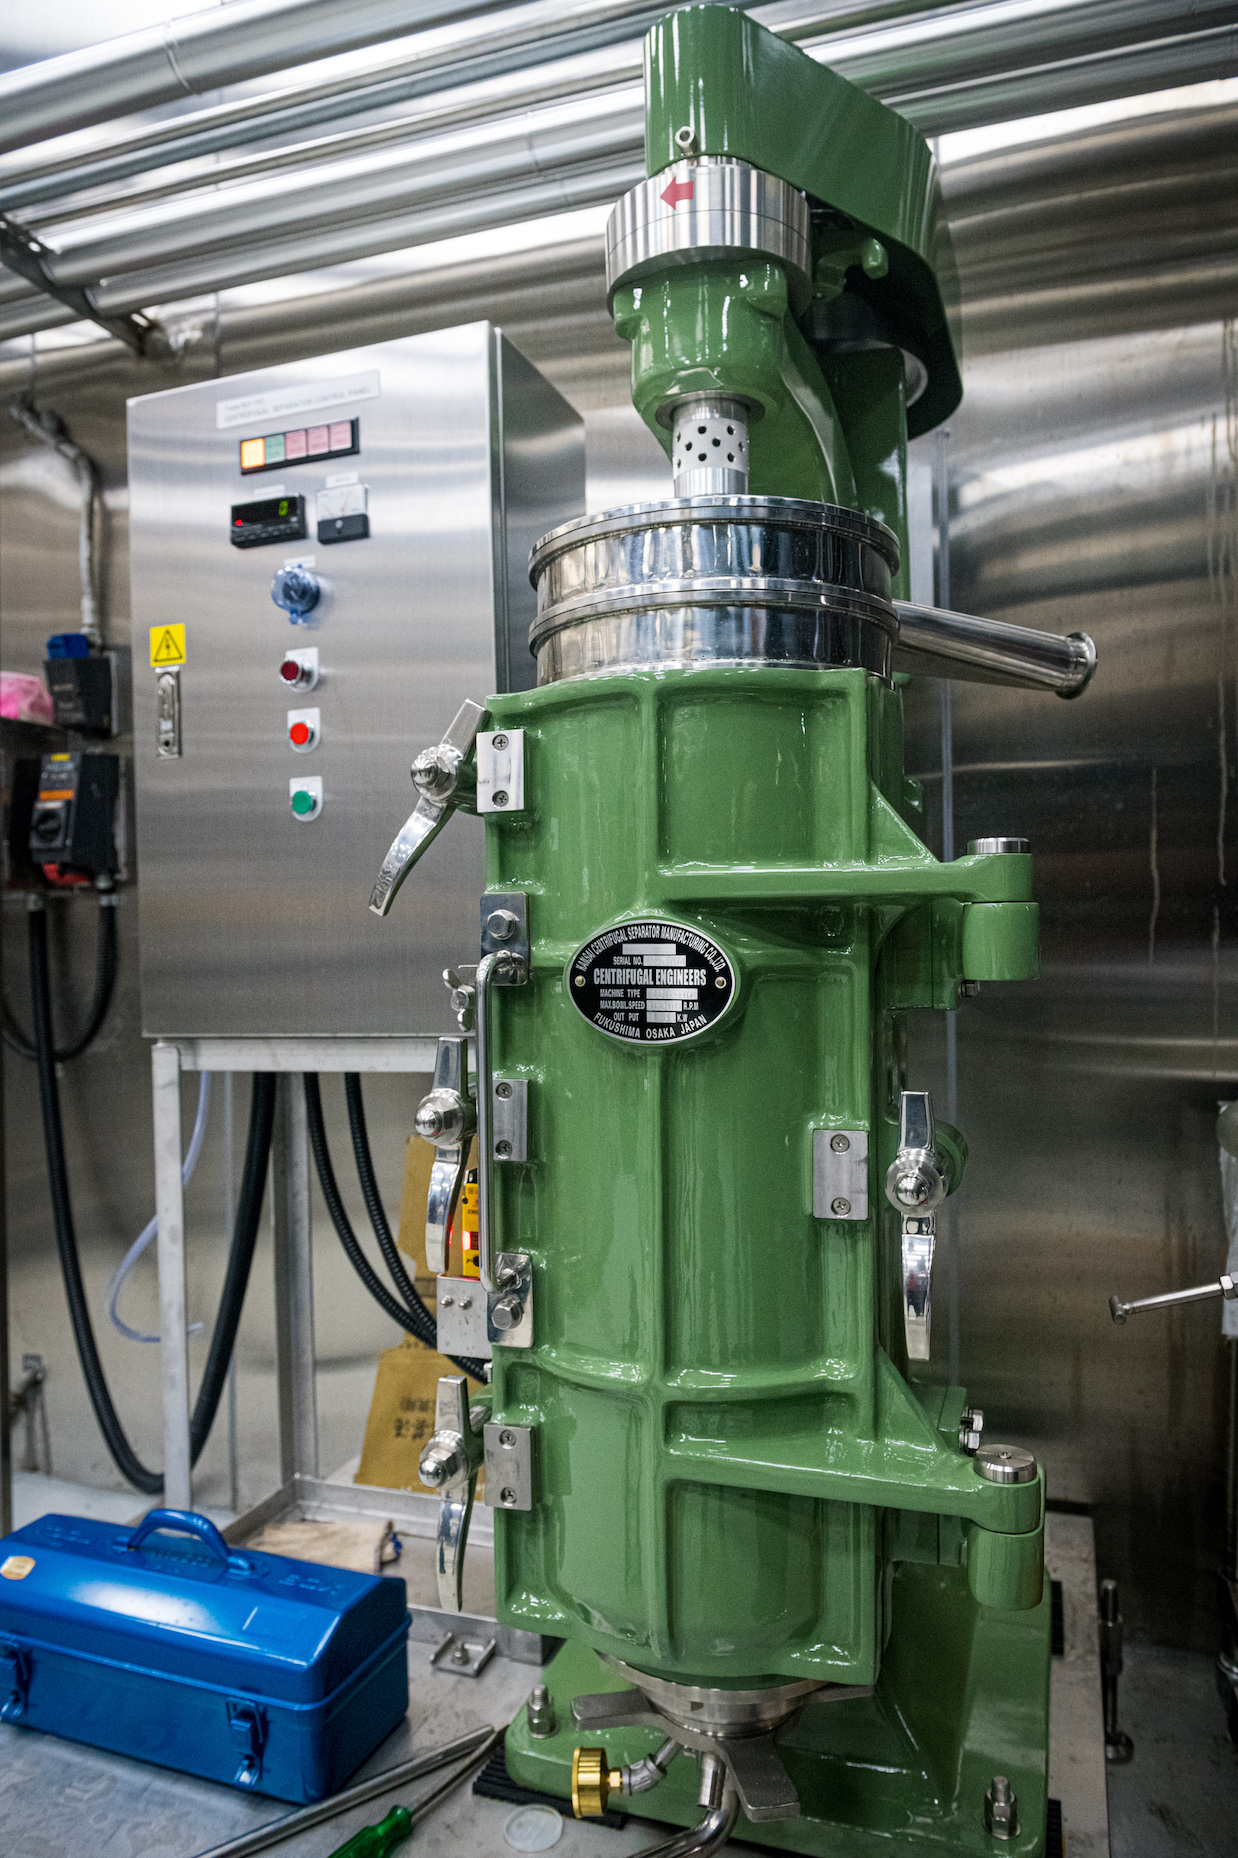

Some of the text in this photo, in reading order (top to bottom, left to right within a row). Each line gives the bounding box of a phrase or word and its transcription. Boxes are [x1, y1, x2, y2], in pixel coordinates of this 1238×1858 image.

[576, 951, 595, 971] KANSAI
[591, 929, 628, 954] CENTRIFUGAL
[628, 925, 660, 940] SEPARATOR
[661, 925, 707, 953] MANUFACTURING
[613, 955, 631, 966] SERIAL
[633, 956, 643, 966] NO.
[593, 968, 707, 986] CENTRIFUGAL ENGINEERS
[600, 988, 625, 998] MACHINE
[627, 989, 641, 998] TYPE
[613, 1012, 625, 1022] OUT
[628, 1012, 639, 1022] PUT
[593, 1012, 708, 1039] FUKUSHIMA OSAKA JAPAN
